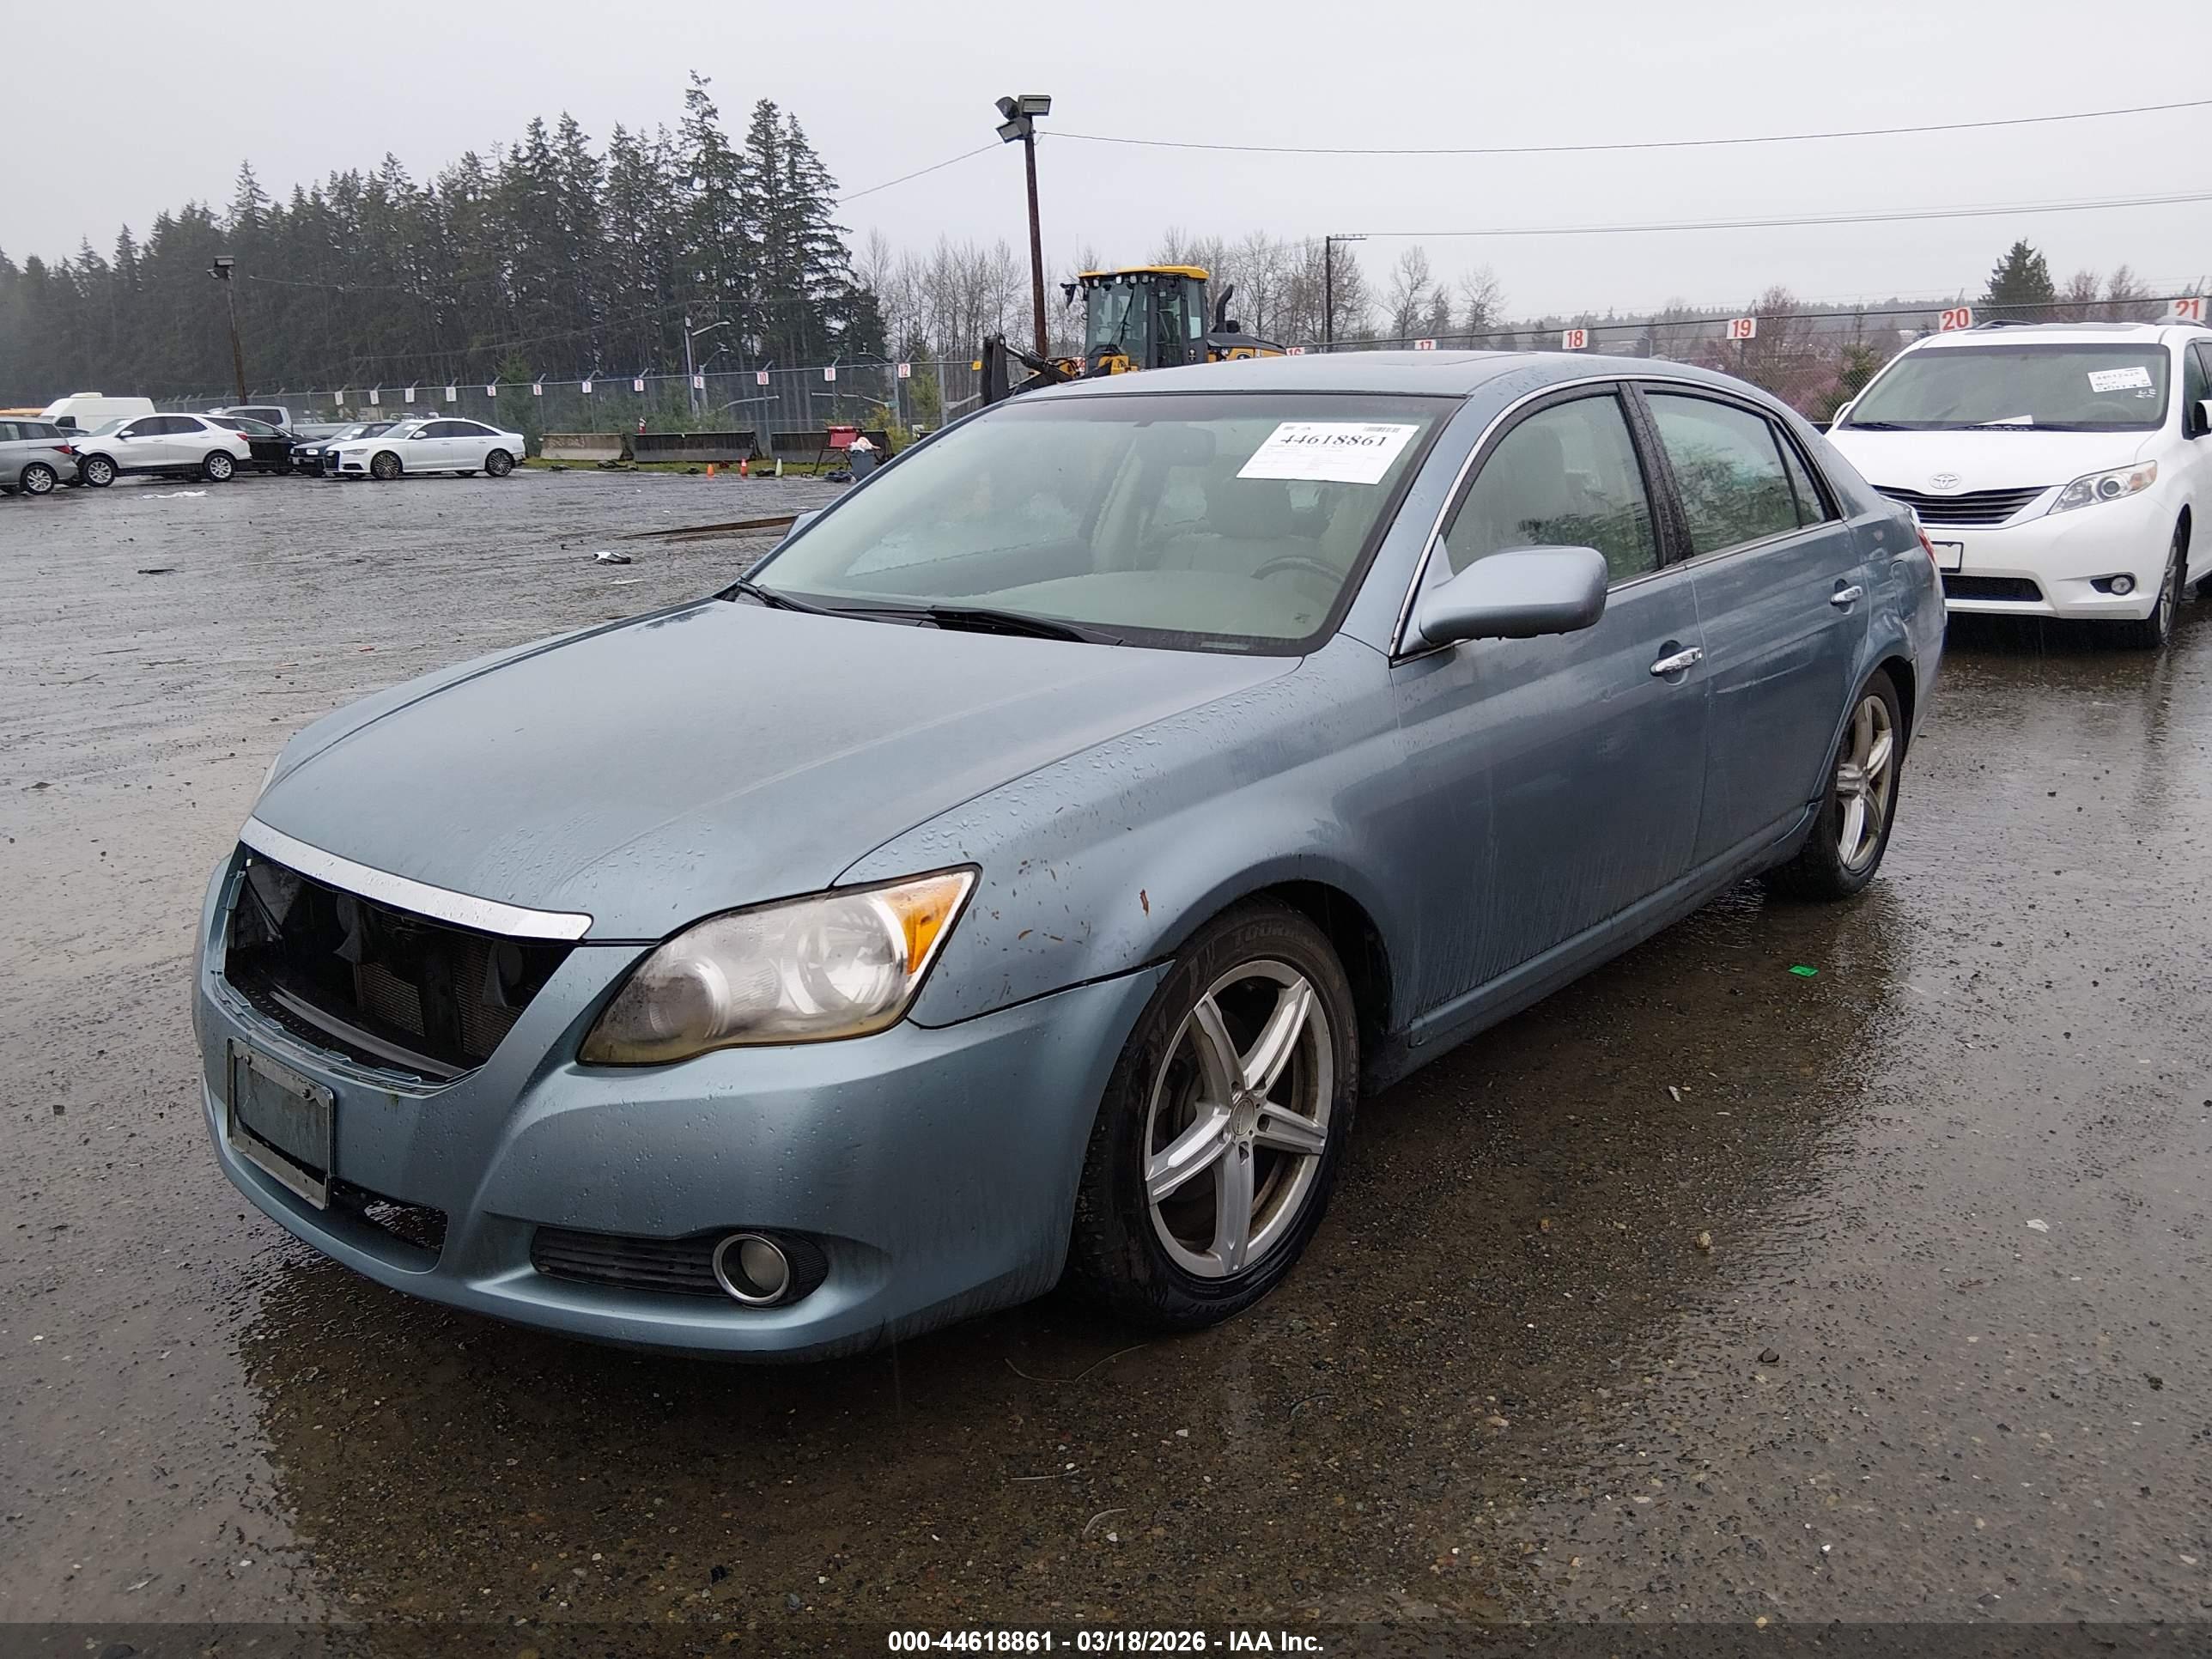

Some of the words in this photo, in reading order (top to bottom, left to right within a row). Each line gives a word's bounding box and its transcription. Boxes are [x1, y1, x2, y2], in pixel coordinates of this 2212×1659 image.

[2174, 299, 2199, 319] 21
[1942, 308, 1969, 331] 20
[1732, 319, 1752, 337] 19
[1419, 340, 1433, 350] 17
[1566, 329, 1584, 348] 18
[827, 369, 834, 380] 11
[900, 364, 908, 377] 12
[759, 373, 767, 384] 10
[1280, 434, 1389, 447] 44618861
